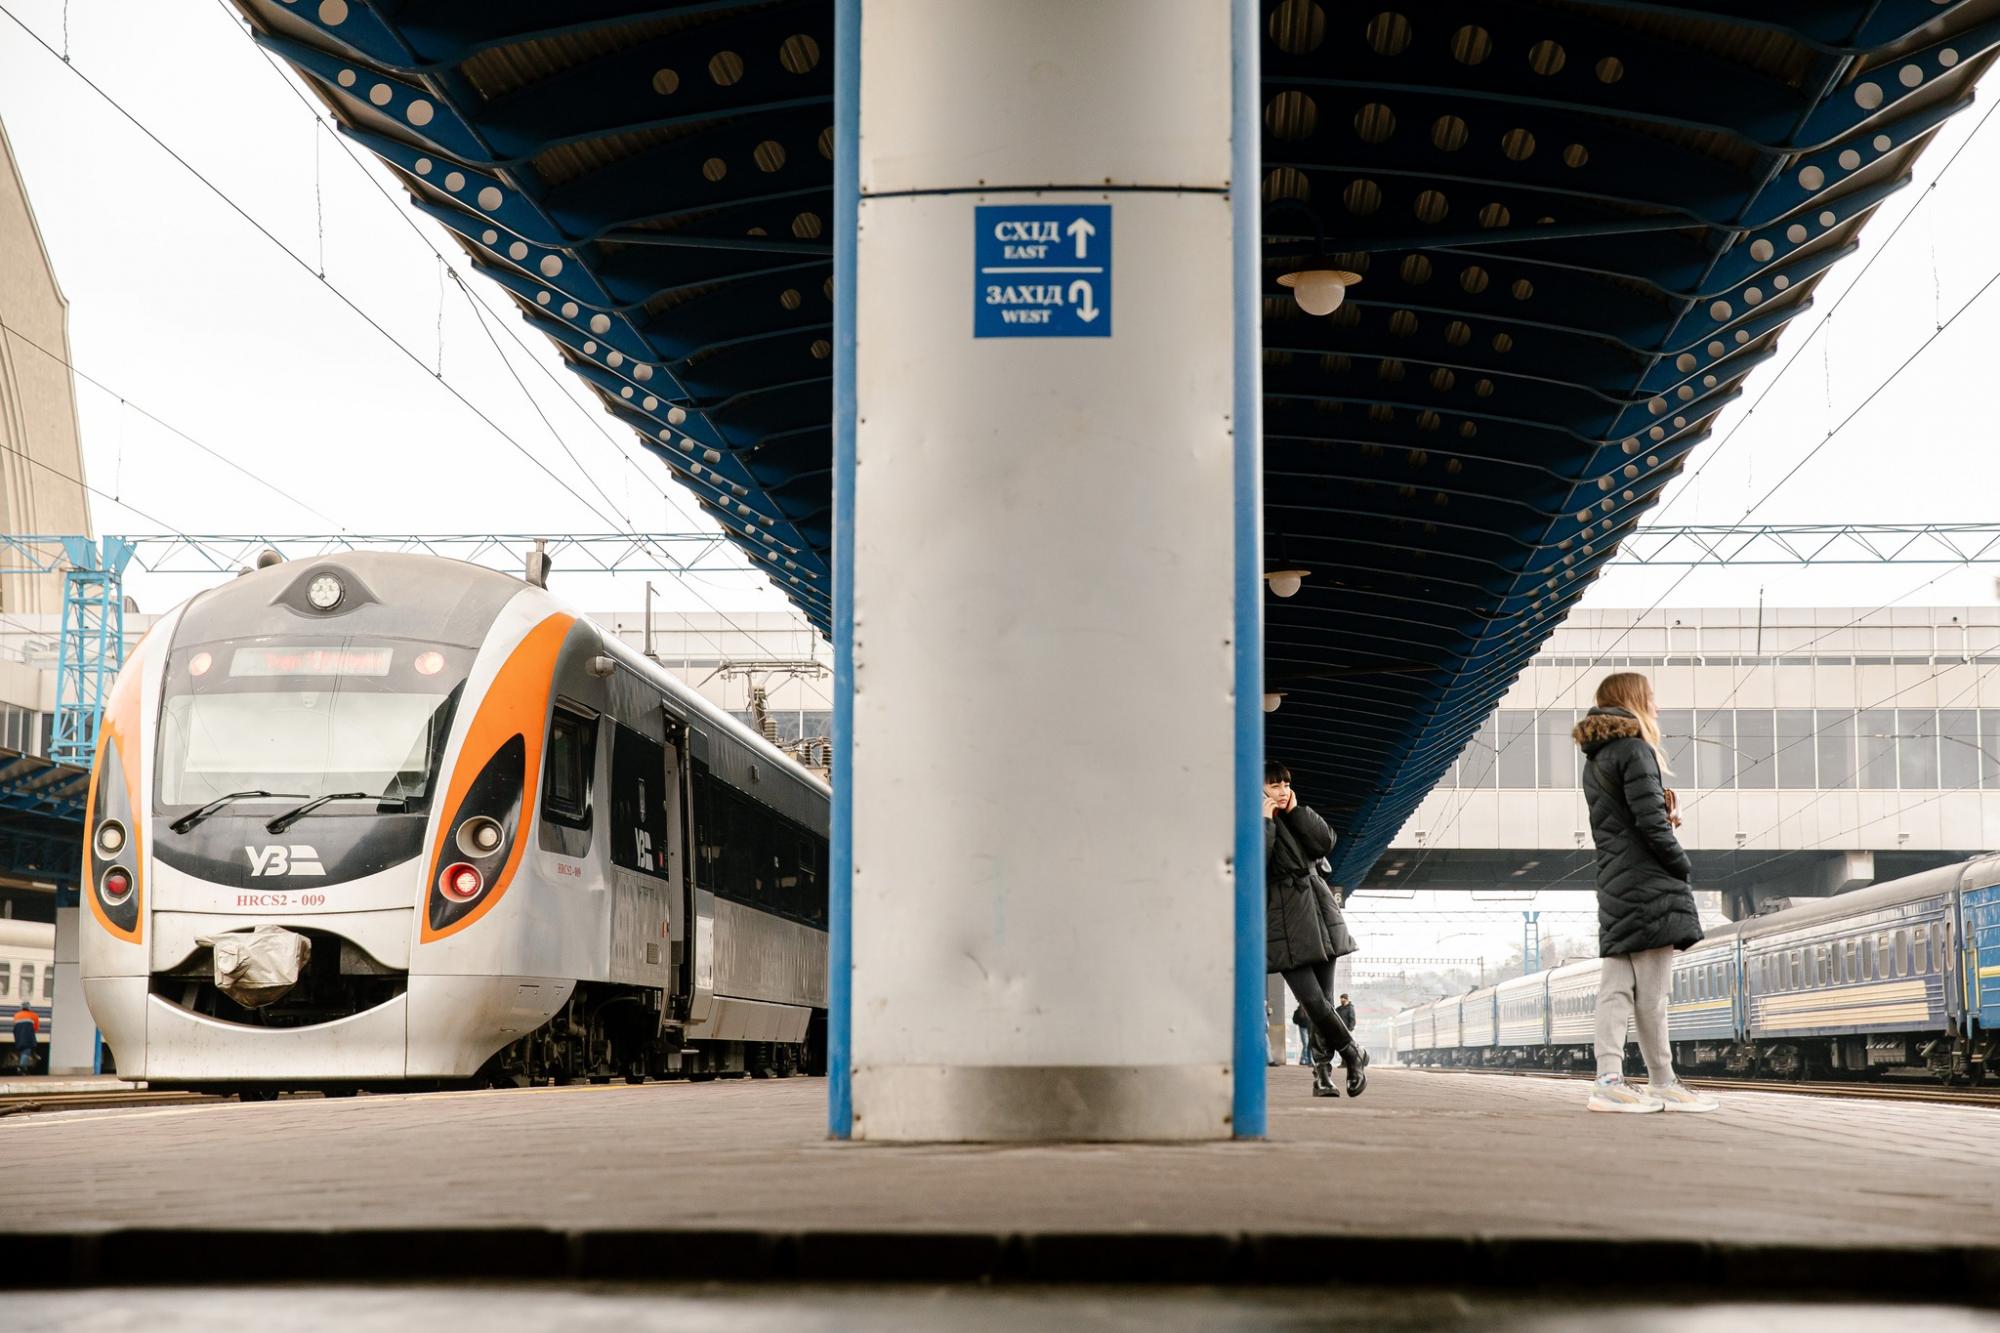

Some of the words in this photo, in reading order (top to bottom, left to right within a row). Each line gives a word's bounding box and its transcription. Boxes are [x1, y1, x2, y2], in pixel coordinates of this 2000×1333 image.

[994, 221, 1060, 243] СХІД
[1004, 245, 1048, 259] EAST
[986, 285, 1063, 306] ЗАХІД
[1002, 309, 1051, 323] WEST
[237, 894, 288, 906] HRCS2
[301, 894, 326, 906] 009
